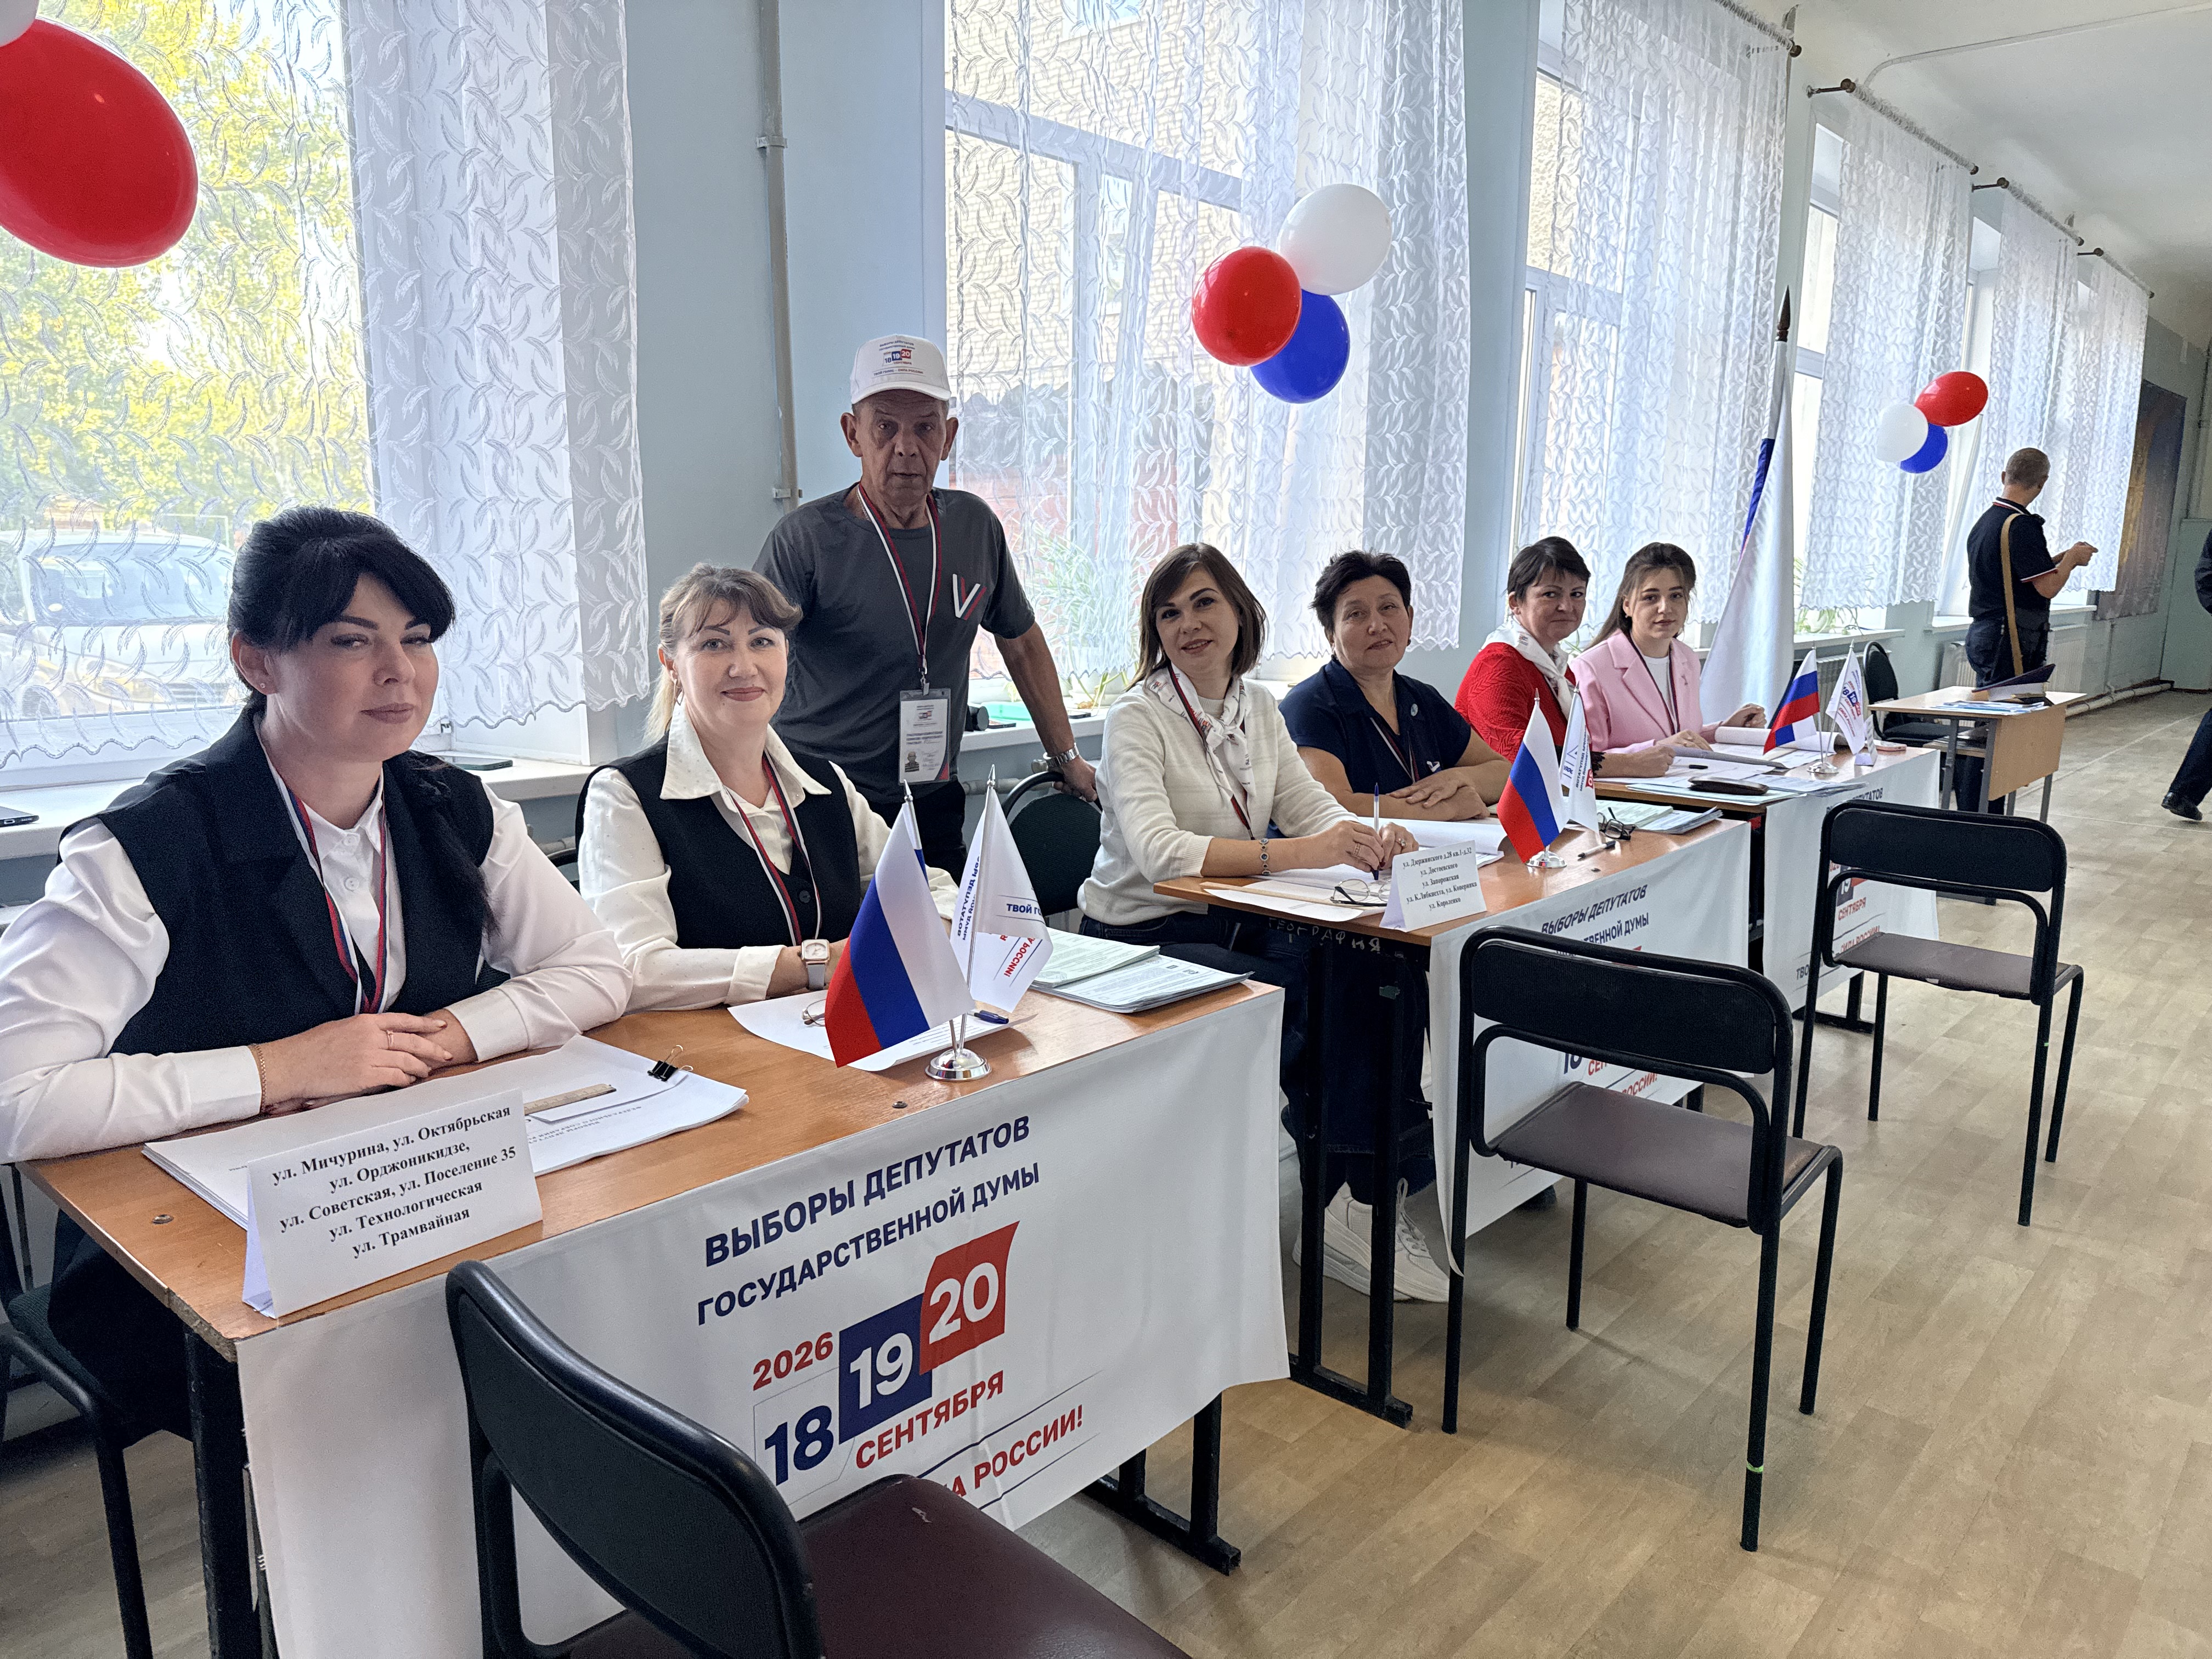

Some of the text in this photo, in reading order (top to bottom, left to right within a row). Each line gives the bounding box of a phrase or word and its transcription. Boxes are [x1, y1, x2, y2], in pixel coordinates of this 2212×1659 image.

[1428, 863, 1458, 876] Достоевского
[1430, 874, 1459, 885] Запорожская
[1453, 882, 1477, 892] Коперника
[1006, 903, 1032, 914] ТВОЙ
[1436, 897, 1461, 908] Короленко
[1542, 906, 1589, 934] ВЫБОРЫ
[1588, 884, 1648, 922] ДЕПУТАТОВ
[1624, 912, 1649, 936] ДУМЫ
[1838, 897, 1866, 921] СЕНТЯБРЯ
[1796, 964, 1810, 980] ТВО
[273, 1107, 511, 1186] ул. Мичурина, ул. Октябрьская
[330, 1142, 470, 1194] ул. Орджоникидзе,
[280, 1146, 516, 1233] ул. Советская, ул. Поселение 35
[329, 1182, 483, 1242] ул. Технологическая
[706, 1116, 1029, 1267] ВЫБОРЫ ДЕПУТАТОВ
[352, 1209, 470, 1259] ул. Трамвайная
[698, 1163, 1040, 1325] ГОСУДАРСТВЕННОЙ ДУМЫ
[753, 1332, 833, 1391] 2026
[765, 1262, 999, 1486] 18 19 20
[856, 1370, 1003, 1469] СЕНТЯБРЯ
[974, 1404, 1084, 1489] РОССИИ!
